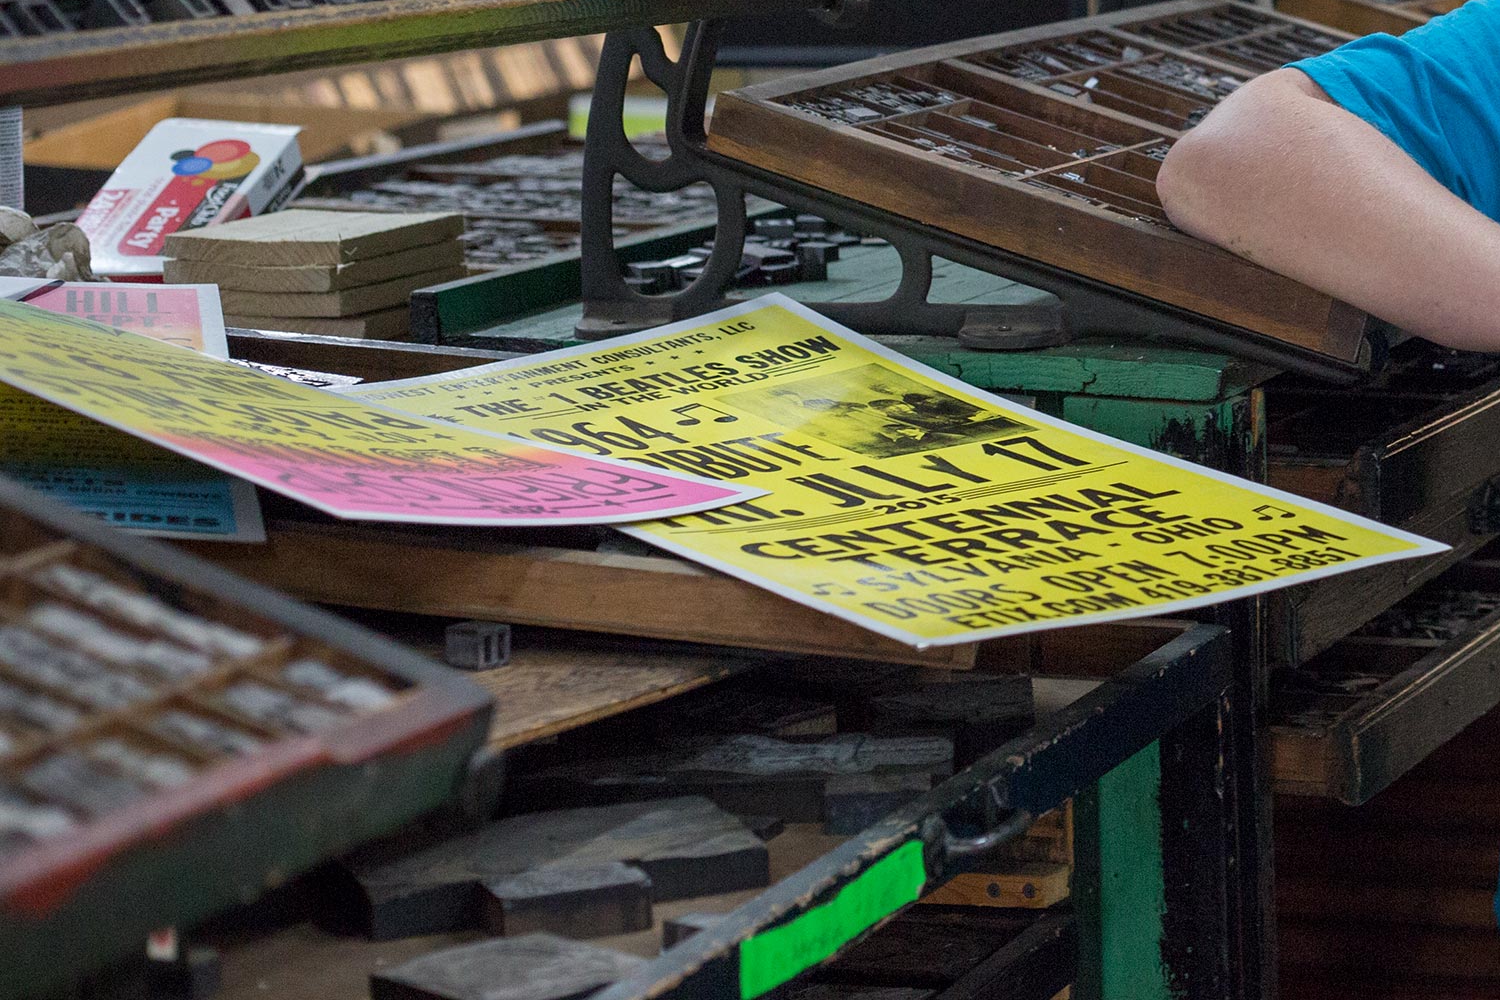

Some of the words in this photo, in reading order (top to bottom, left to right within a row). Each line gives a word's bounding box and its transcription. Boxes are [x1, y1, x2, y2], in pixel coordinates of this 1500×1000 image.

[126, 205, 180, 249] Party
[437, 358, 587, 390] ENTERTAINMENT
[590, 330, 722, 364] CONSULTANTS,
[720, 320, 756, 337] LLC
[454, 398, 543, 418] THE
[575, 361, 740, 402] BEATLES
[734, 334, 842, 371] SHOW
[527, 363, 637, 389] PRESENTS
[572, 401, 611, 413] IN
[608, 388, 672, 406] THE
[668, 371, 772, 396] WORLD
[980, 436, 1093, 473] 17
[740, 482, 1183, 561] CENTENNIAL
[824, 503, 1195, 572] TERRACE
[871, 492, 964, 516] 2015
[855, 545, 1104, 593] SYLVANIA
[1130, 516, 1245, 546] OHIO
[862, 582, 1043, 620] DOORS
[1040, 558, 1181, 593] OPEN
[1162, 523, 1350, 569] 7:00PM
[945, 590, 1145, 631] ETIX.COM
[1137, 546, 1363, 600] 419-381-8851
